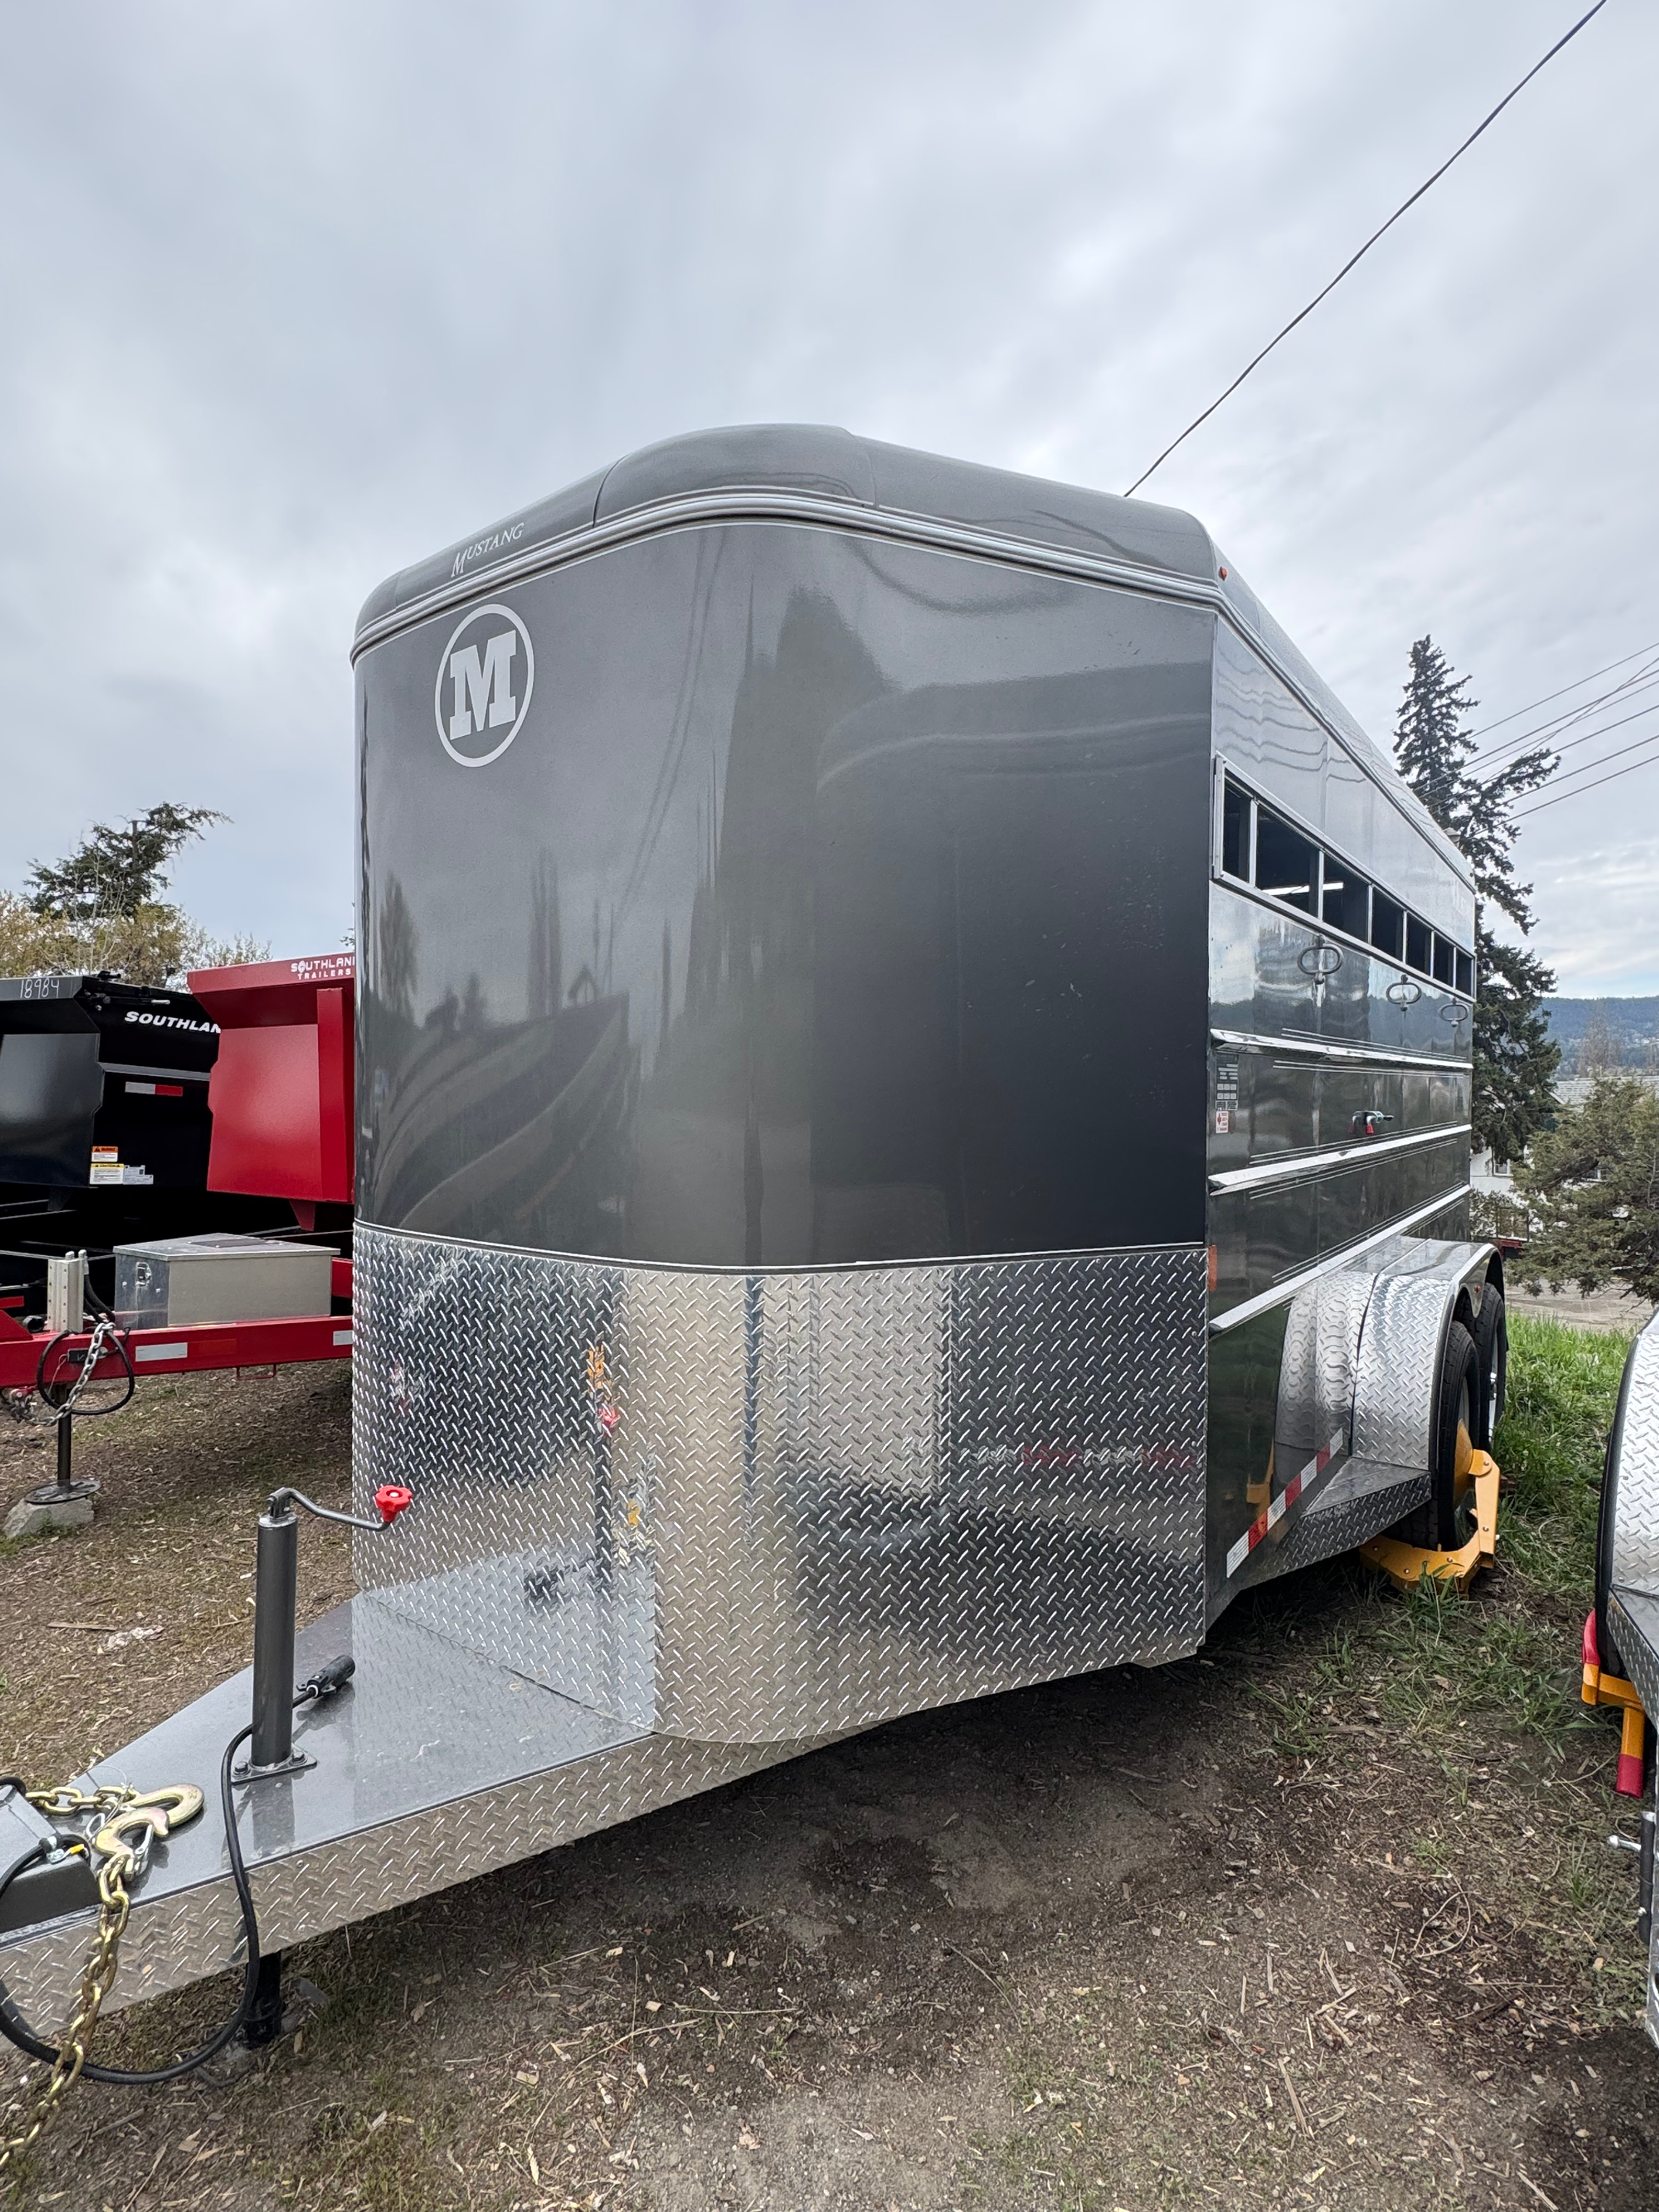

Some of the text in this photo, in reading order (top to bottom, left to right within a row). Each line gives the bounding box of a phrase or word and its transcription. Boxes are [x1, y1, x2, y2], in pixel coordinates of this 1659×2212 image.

[450, 522, 524, 578] MUSTANG
[450, 630, 516, 740] M
[20, 977, 60, 998] 18984
[297, 968, 351, 980] TRAILERS
